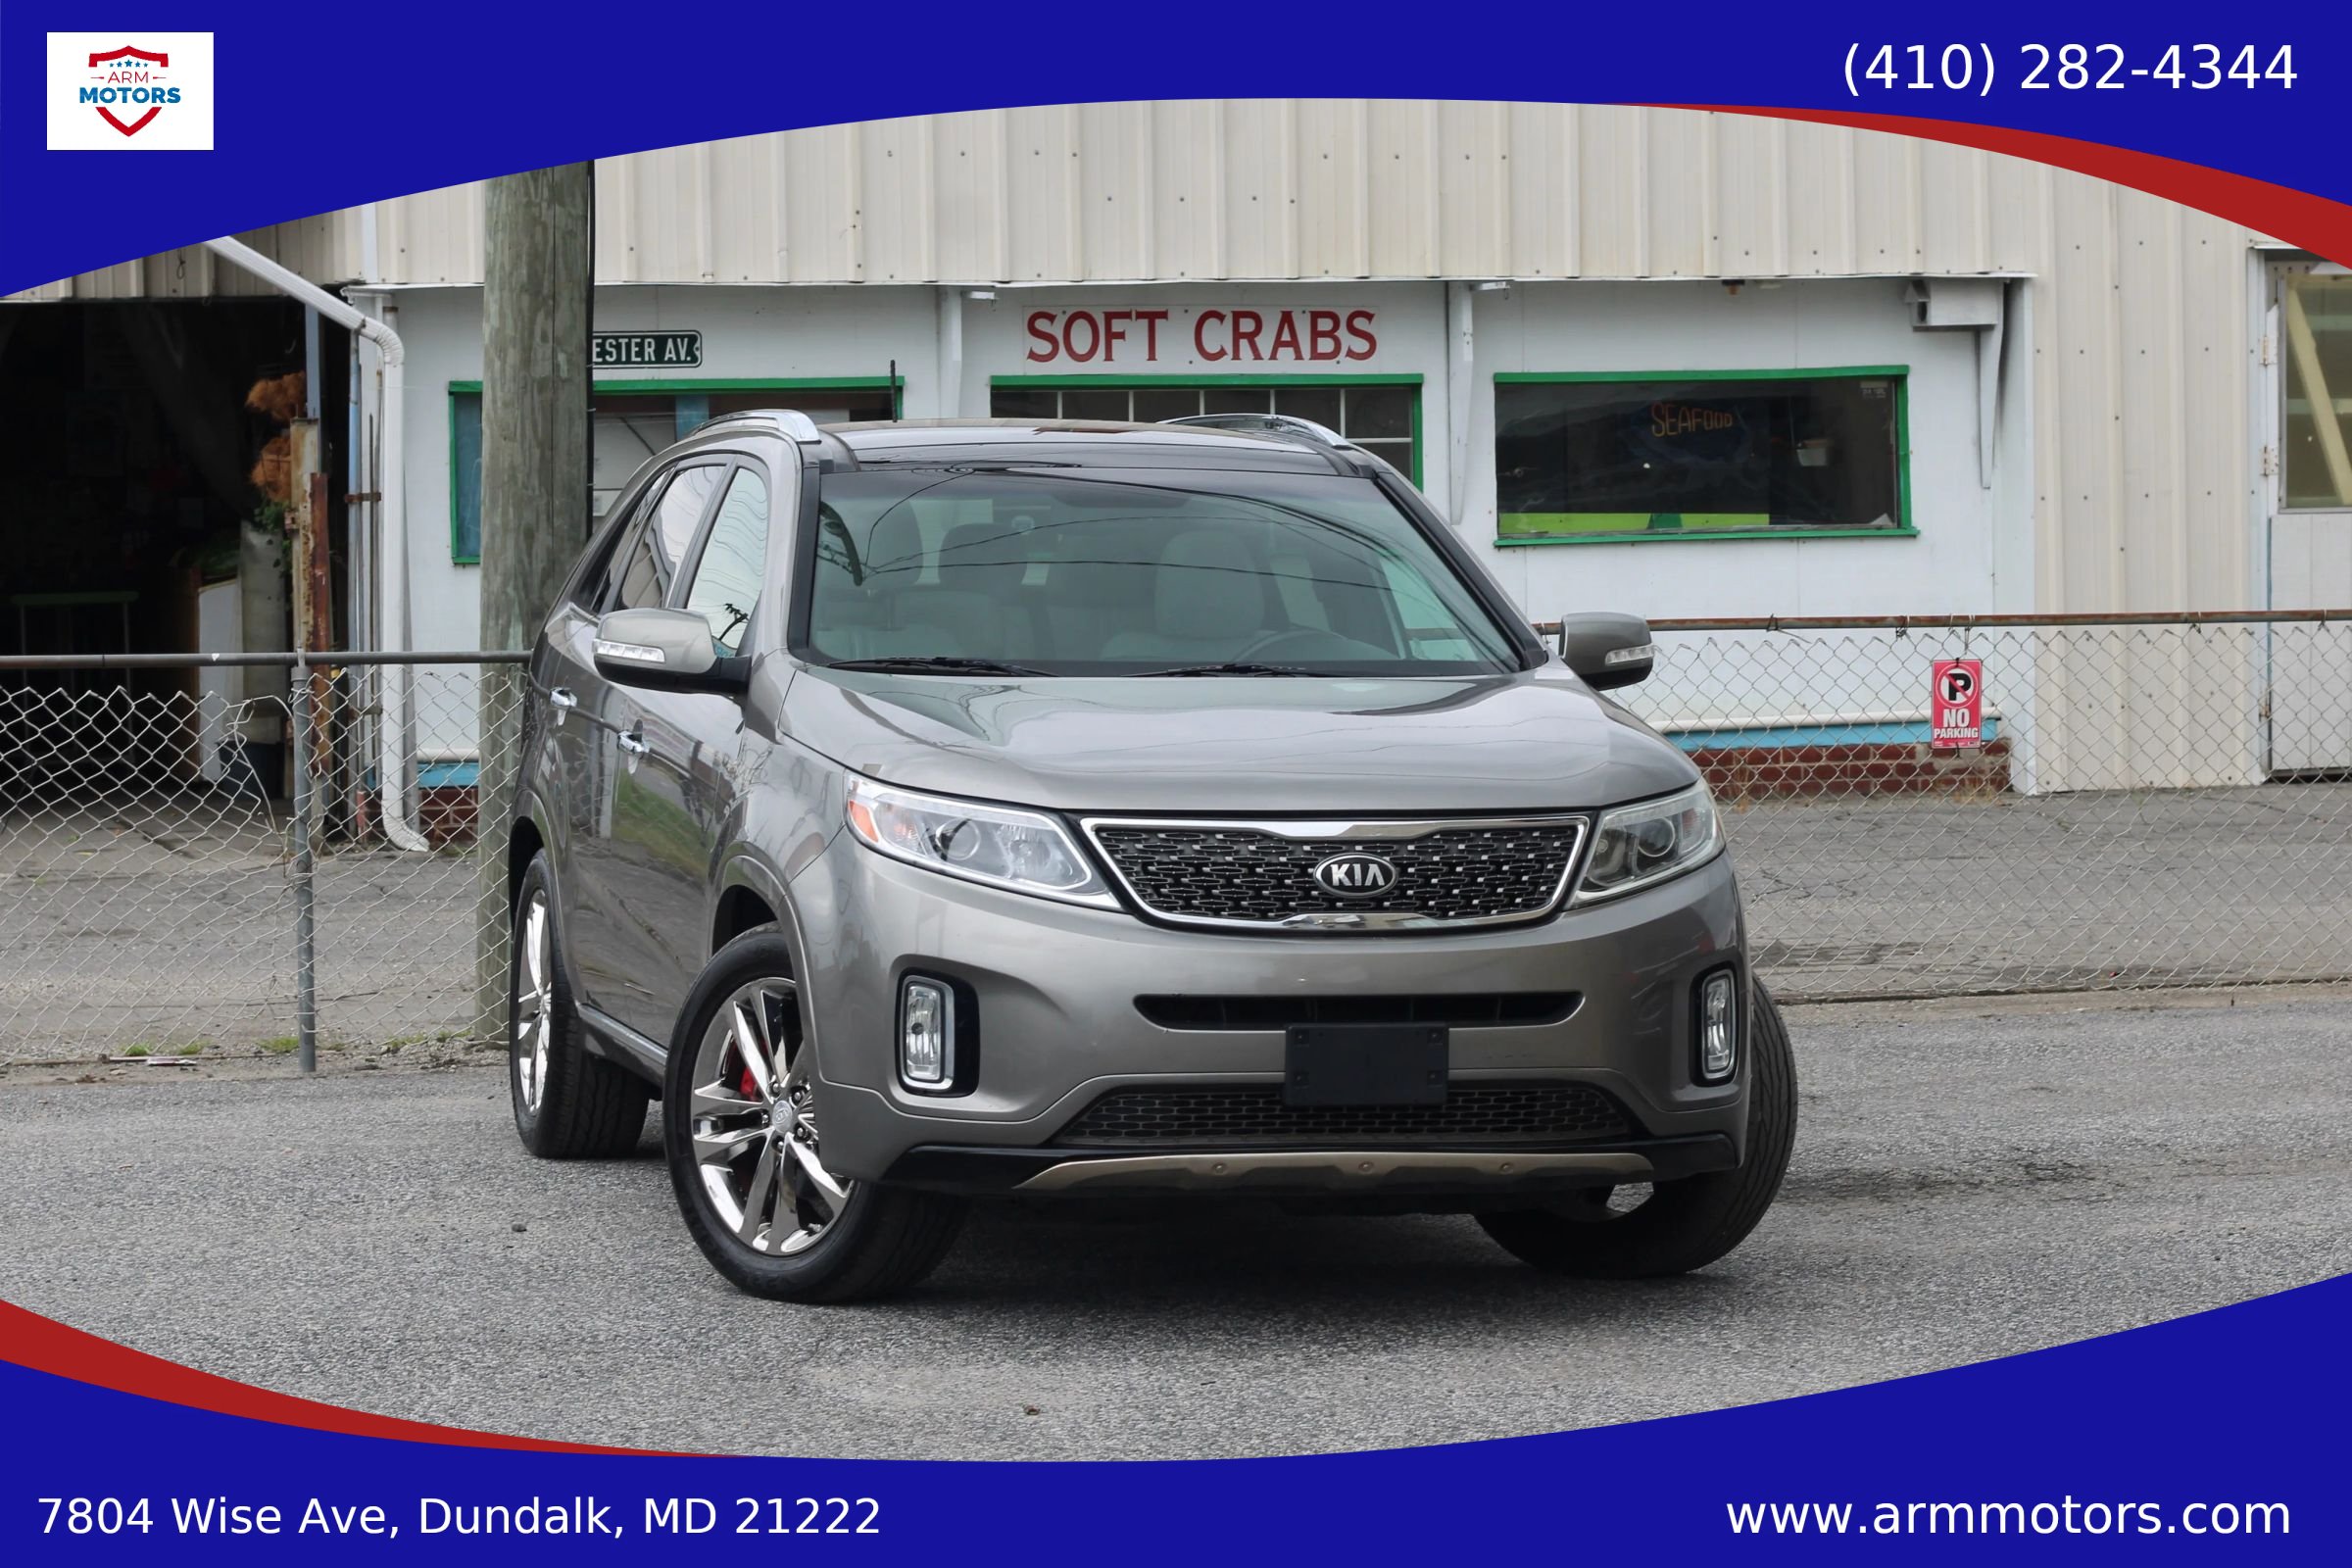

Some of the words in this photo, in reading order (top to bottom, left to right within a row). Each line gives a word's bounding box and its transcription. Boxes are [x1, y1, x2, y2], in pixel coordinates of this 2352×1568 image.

[1026, 310, 1169, 363] SOFT
[1194, 310, 1378, 362] CRABS
[663, 337, 692, 362] AV.
[1650, 402, 1734, 438] SEAFOOD
[1942, 708, 1971, 728] NO
[1934, 727, 1979, 739] PARKING
[1330, 863, 1386, 886] KIA
